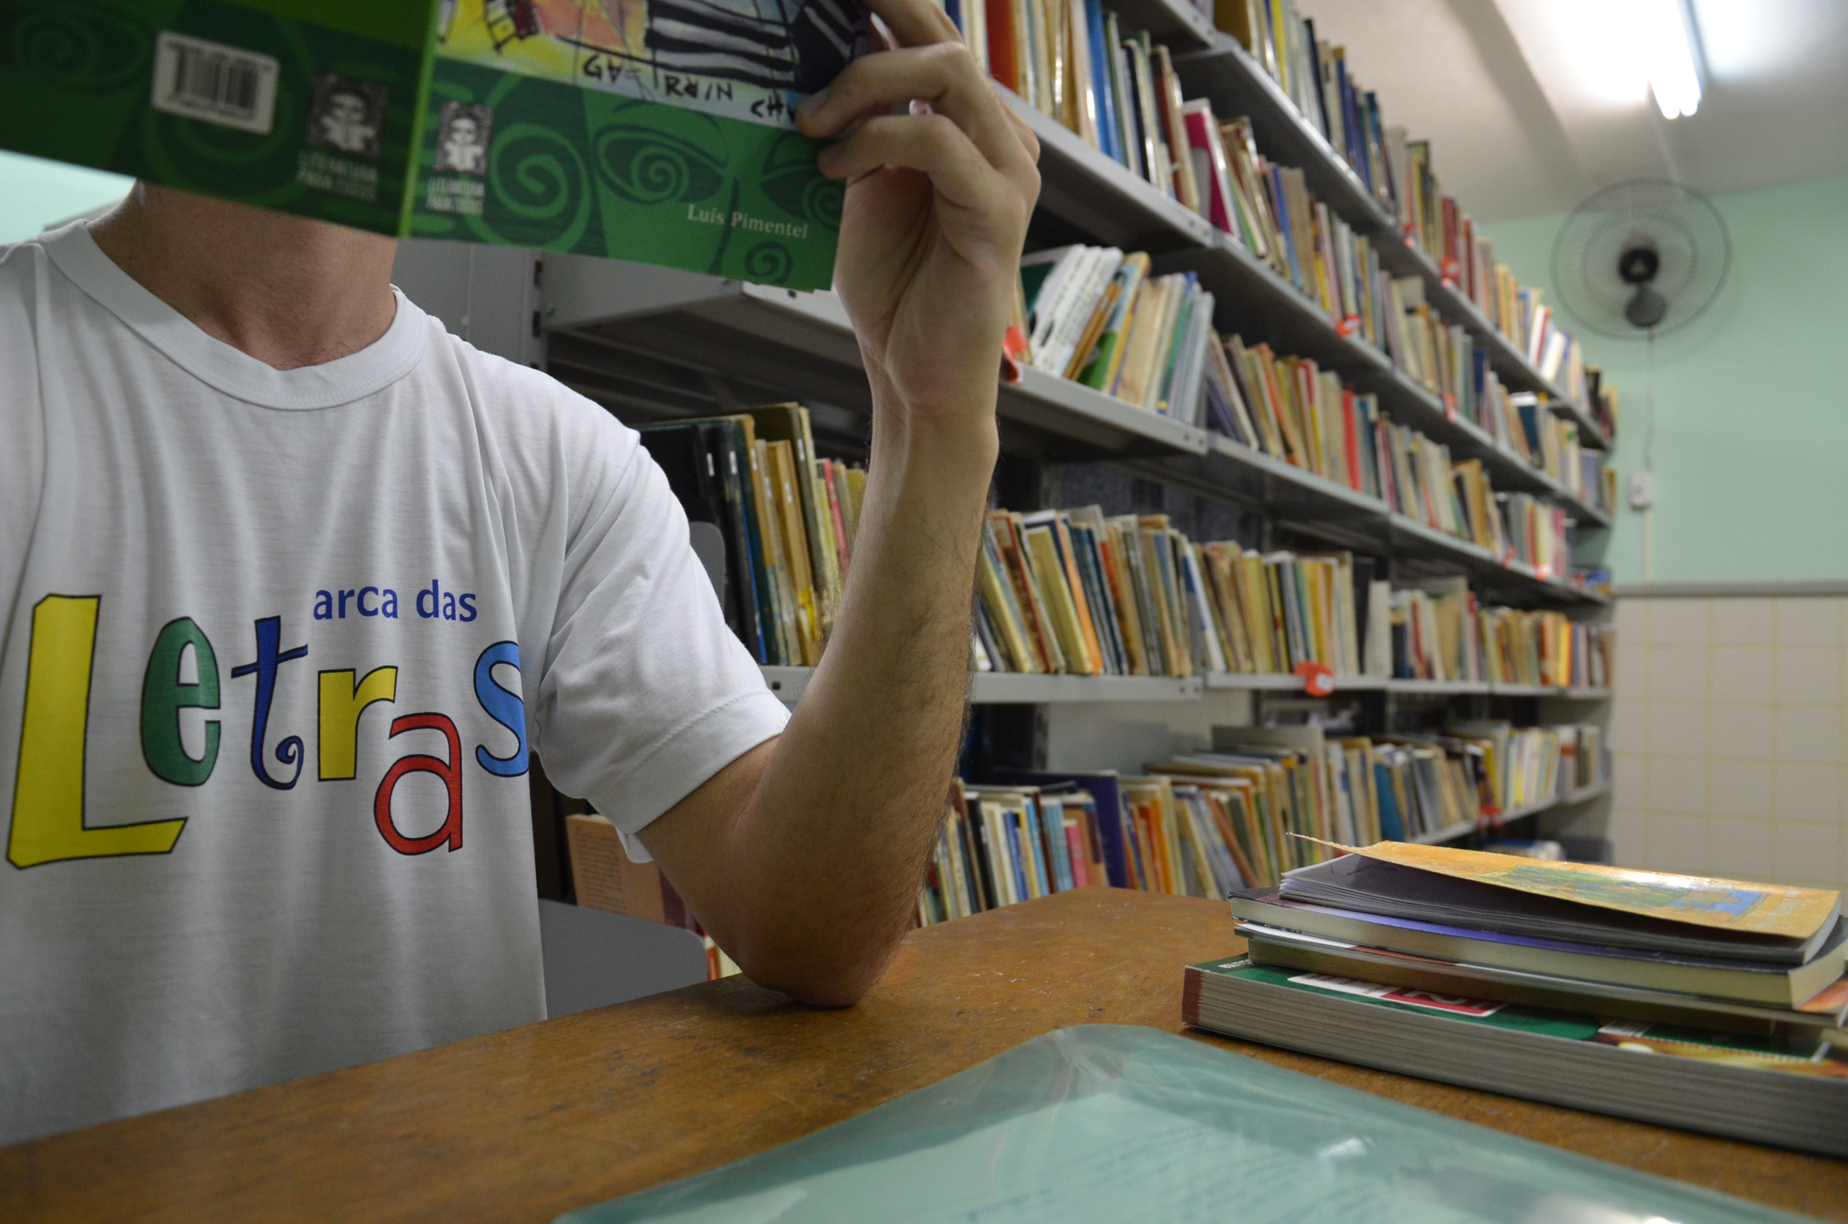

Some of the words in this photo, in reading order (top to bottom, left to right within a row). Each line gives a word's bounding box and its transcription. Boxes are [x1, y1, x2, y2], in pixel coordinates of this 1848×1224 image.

[731, 211, 808, 239] Pimentel
[313, 586, 399, 621] arca
[415, 579, 478, 623] das
[6, 592, 530, 869] Letras
